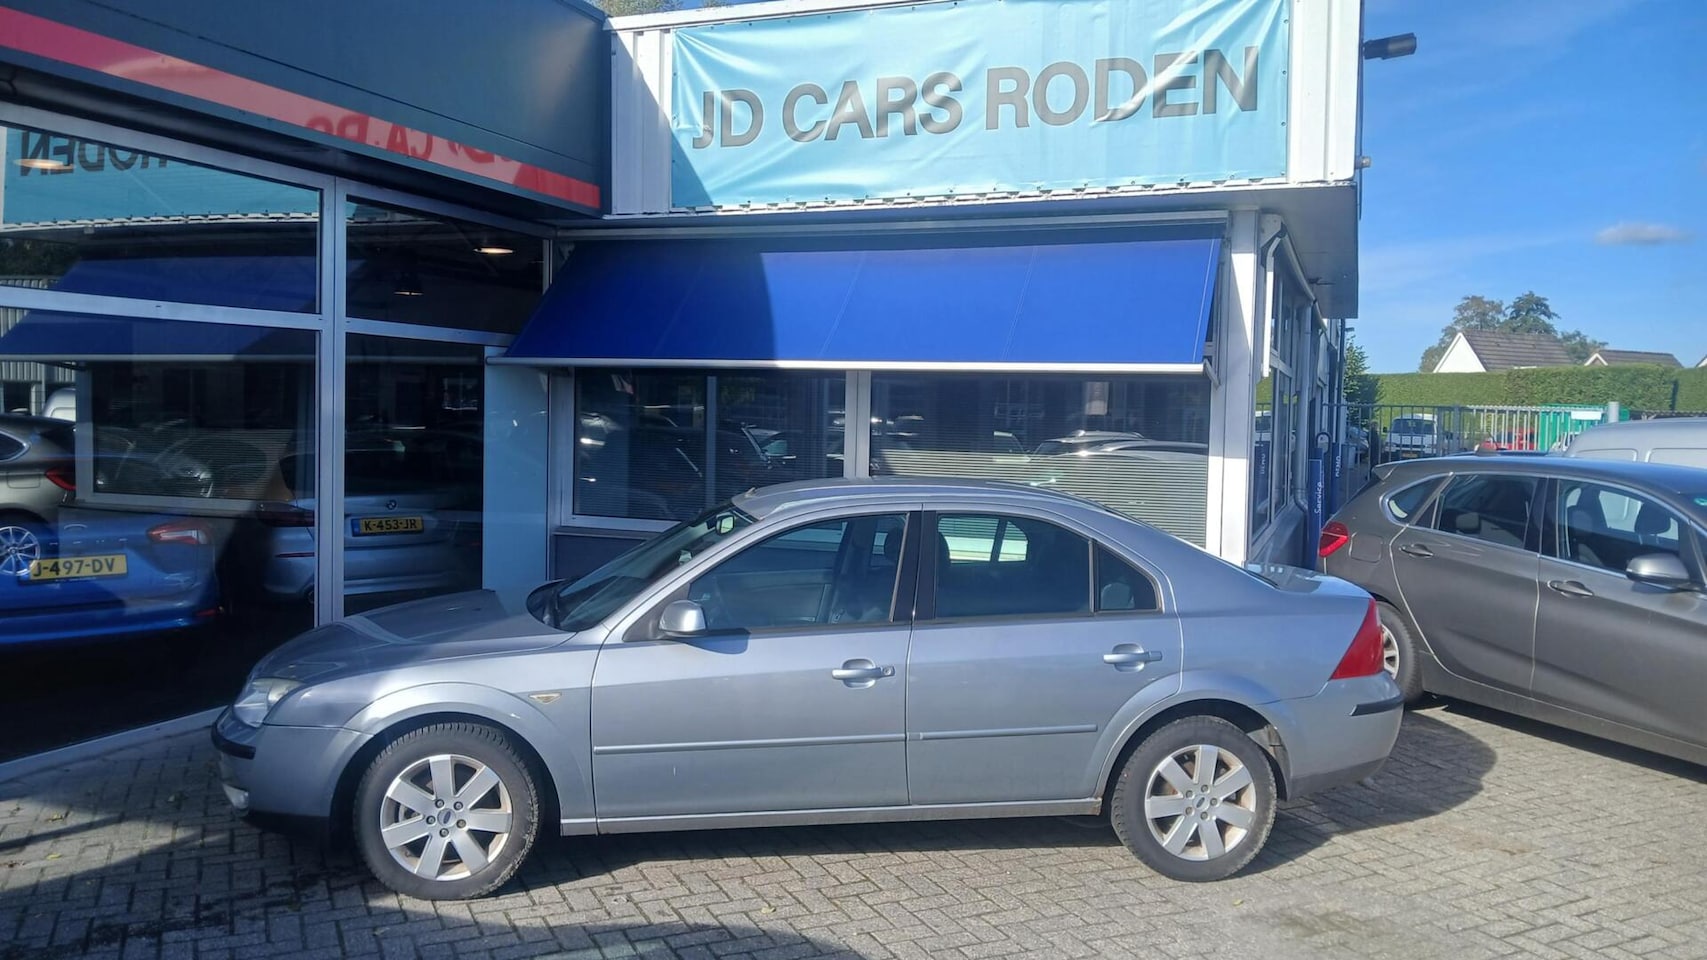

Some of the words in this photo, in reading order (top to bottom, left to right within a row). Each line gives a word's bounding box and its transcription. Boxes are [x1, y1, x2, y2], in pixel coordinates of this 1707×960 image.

[692, 89, 764, 150] JD
[782, 71, 963, 143] CARS
[985, 45, 1259, 130] RODEN
[364, 518, 418, 532] K-453-JR
[32, 557, 116, 577] J-497-DV
